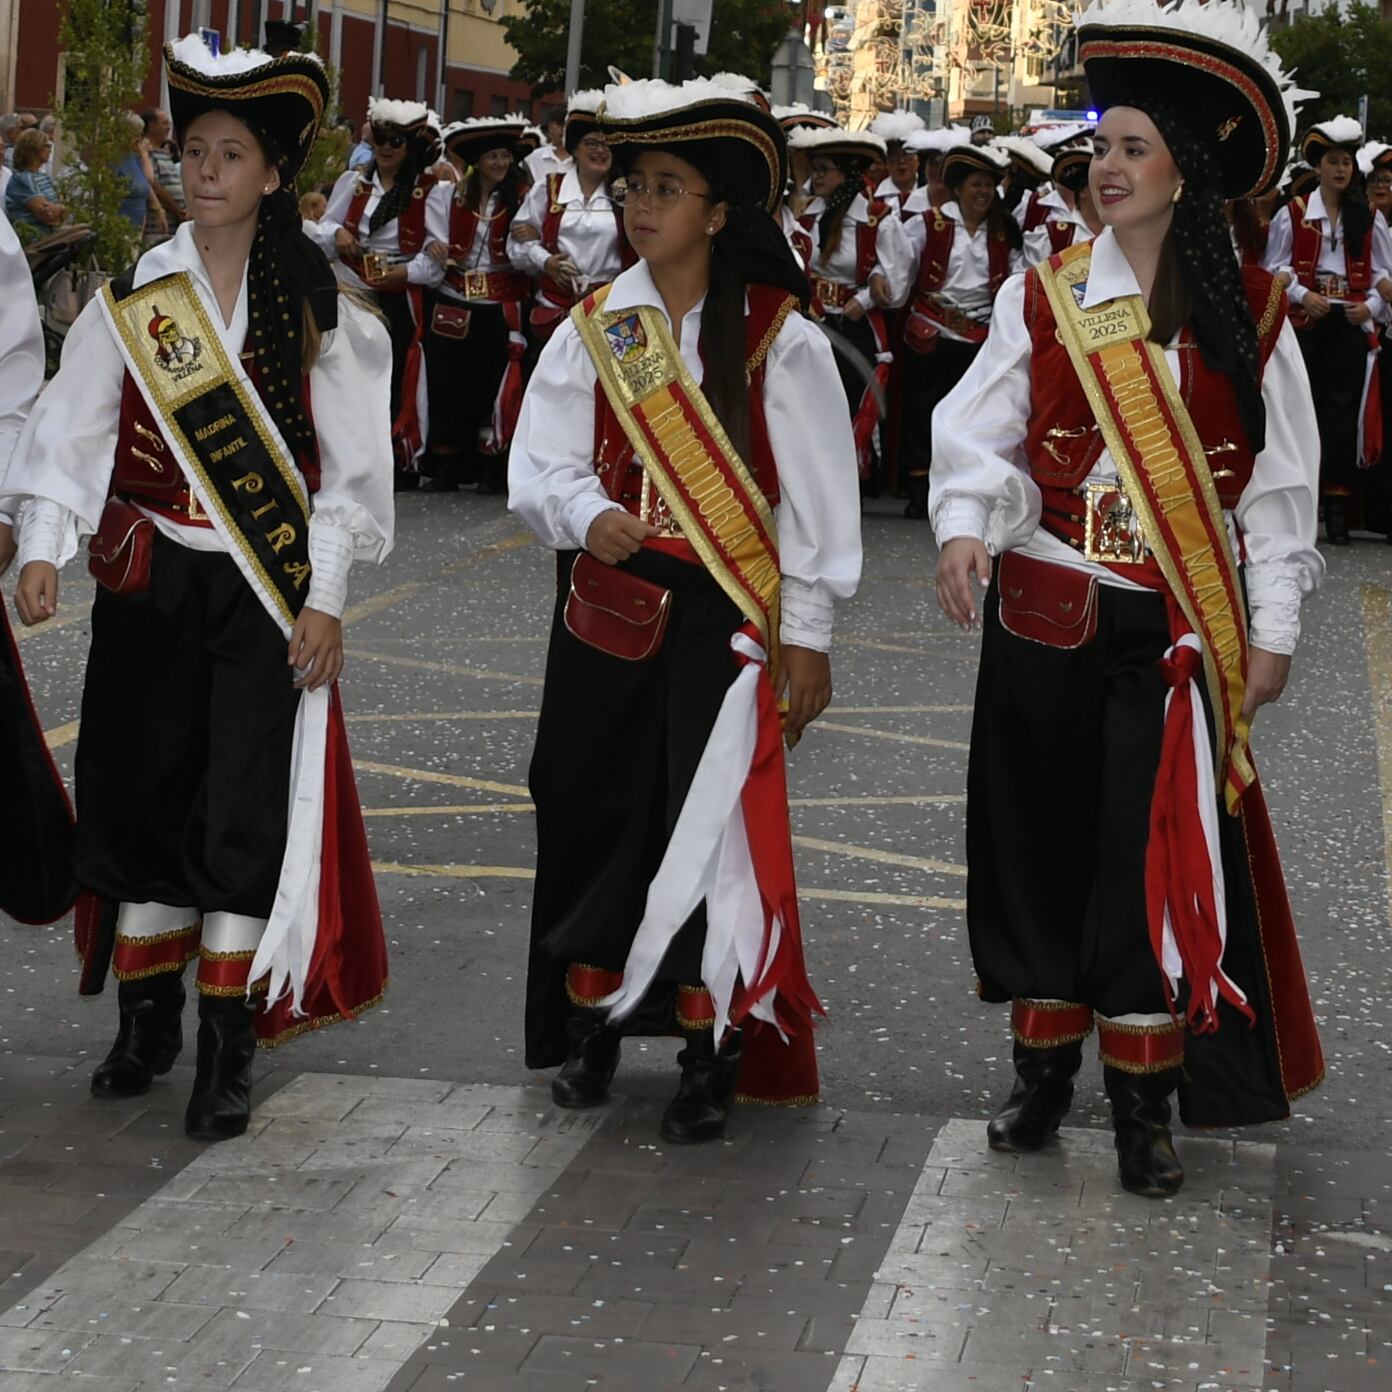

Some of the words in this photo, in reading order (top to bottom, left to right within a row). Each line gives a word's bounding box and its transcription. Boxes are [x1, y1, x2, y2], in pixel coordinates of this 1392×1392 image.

[1078, 308, 1130, 329] VILLENA
[1089, 320, 1128, 340] 2025
[172, 362, 205, 383] VILLENA
[617, 352, 665, 381] VILLENA
[630, 366, 664, 393] 2025
[194, 413, 238, 442] MADRINA
[1100, 349, 1197, 519] REGIDORA
[208, 436, 249, 464] INFANTIL
[645, 400, 757, 557] REGIDORA
[1179, 542, 1242, 675] MAYOR
